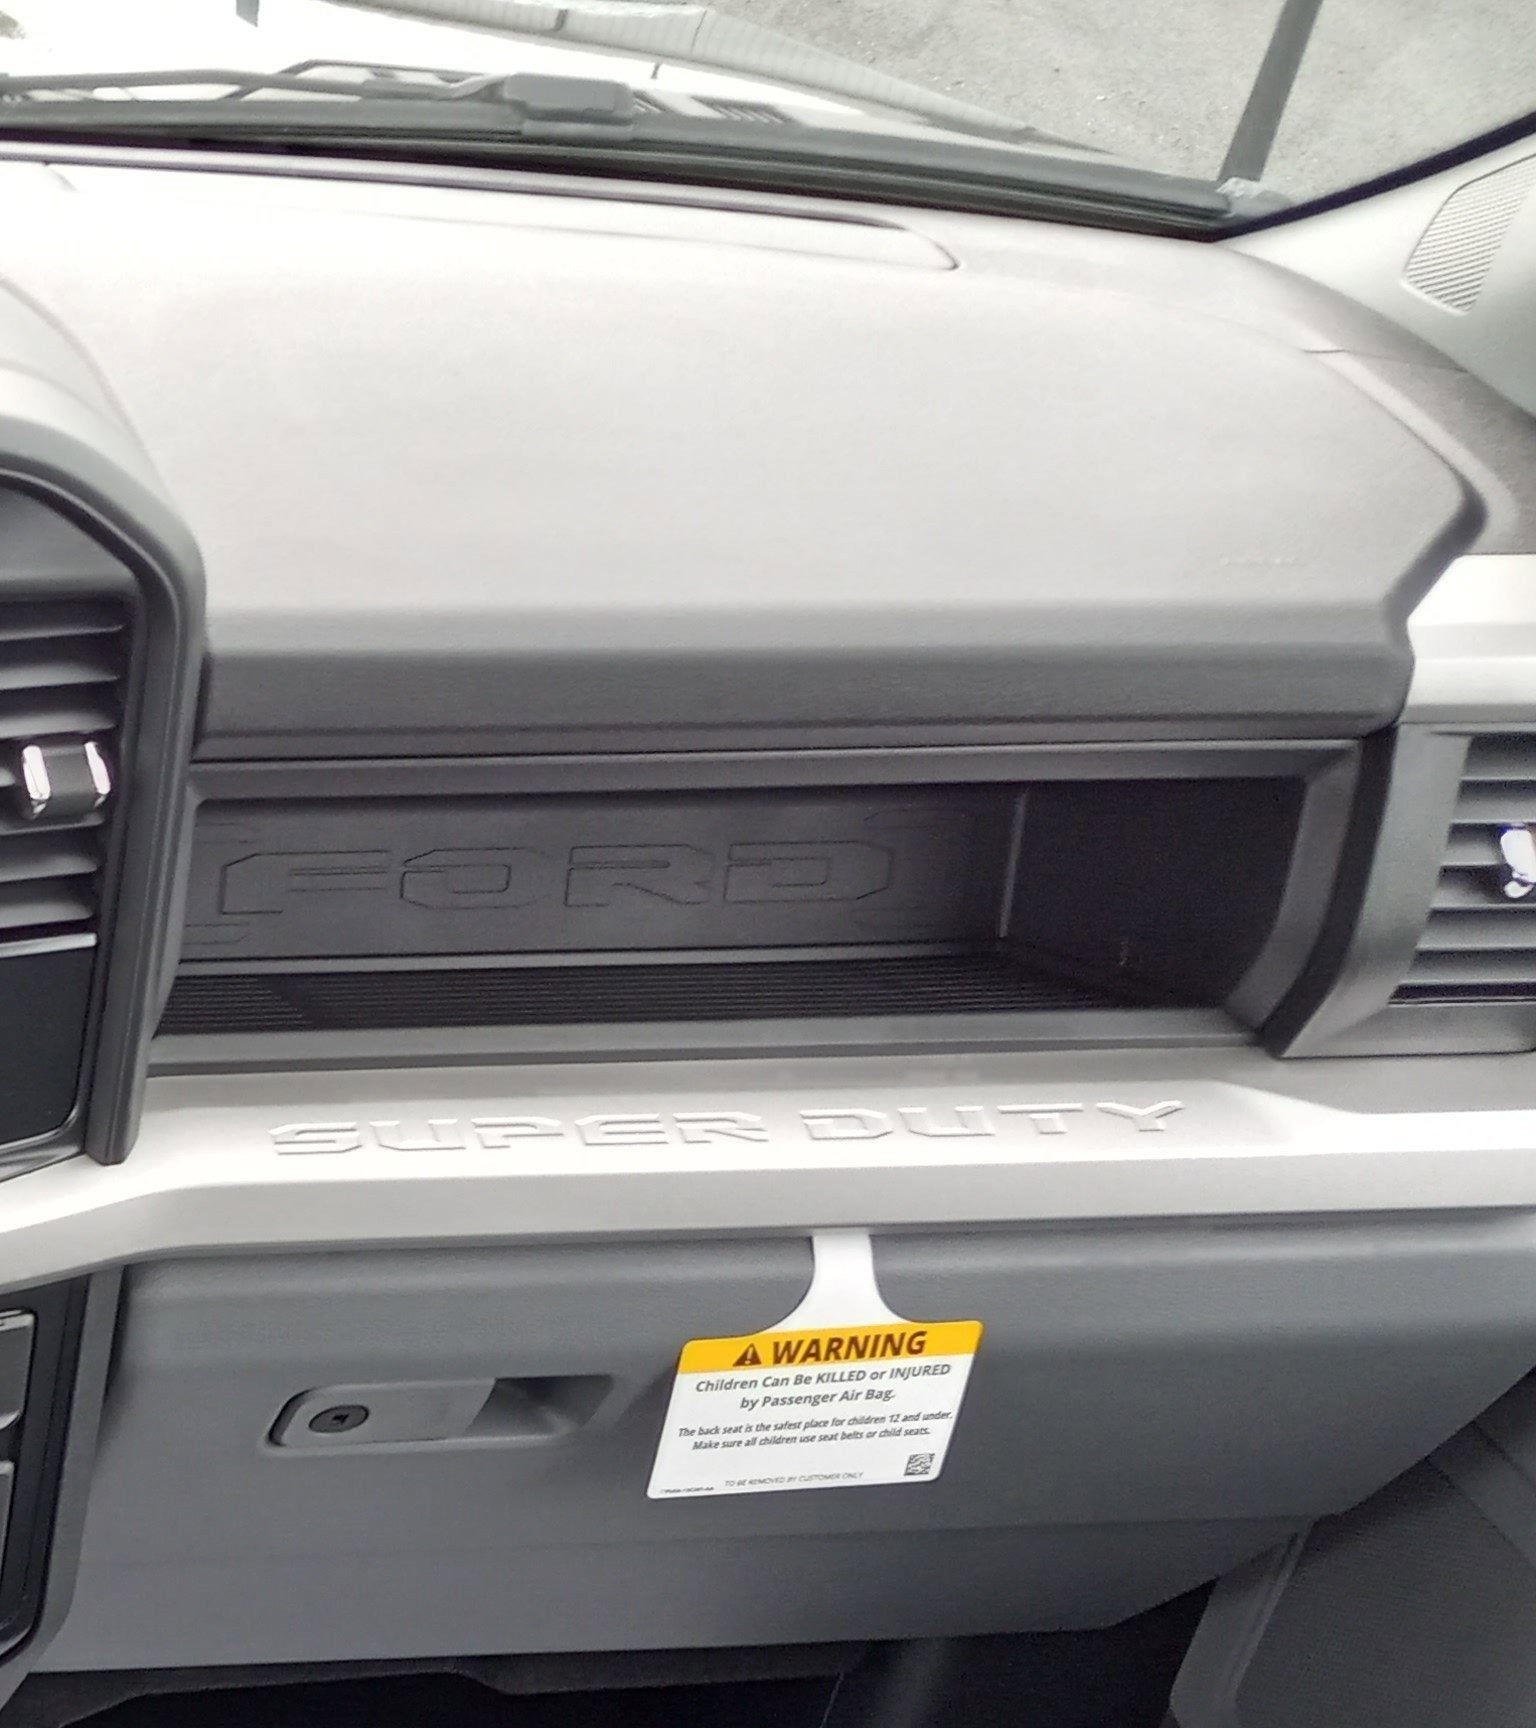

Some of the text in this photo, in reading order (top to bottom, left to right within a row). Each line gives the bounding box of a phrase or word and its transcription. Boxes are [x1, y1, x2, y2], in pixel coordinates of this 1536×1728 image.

[218, 841, 892, 915] FORD
[269, 1100, 1184, 1155] SUPER DUTY
[773, 1331, 927, 1364] WARNING
[695, 1364, 951, 1393] Children Can Be KILLED or INJURED
[740, 1389, 895, 1411] by Passenger Air Bag.
[678, 1427, 696, 1438] The
[698, 1426, 719, 1435] back
[722, 1425, 743, 1434] seat
[745, 1424, 754, 1433] is
[755, 1422, 769, 1432] the
[773, 1421, 801, 1431] safest
[803, 1419, 828, 1431] place
[830, 1417, 846, 1428] for
[847, 1415, 886, 1426] children
[889, 1414, 900, 1423] 12
[901, 1412, 922, 1422] and
[692, 1440, 720, 1450] Make
[721, 1439, 742, 1448] sure
[744, 1437, 757, 1447] all
[758, 1435, 797, 1446] children
[799, 1434, 815, 1443] use
[818, 1433, 838, 1442] seat
[840, 1430, 863, 1440] belts
[866, 1430, 877, 1438] or
[879, 1427, 902, 1438] child
